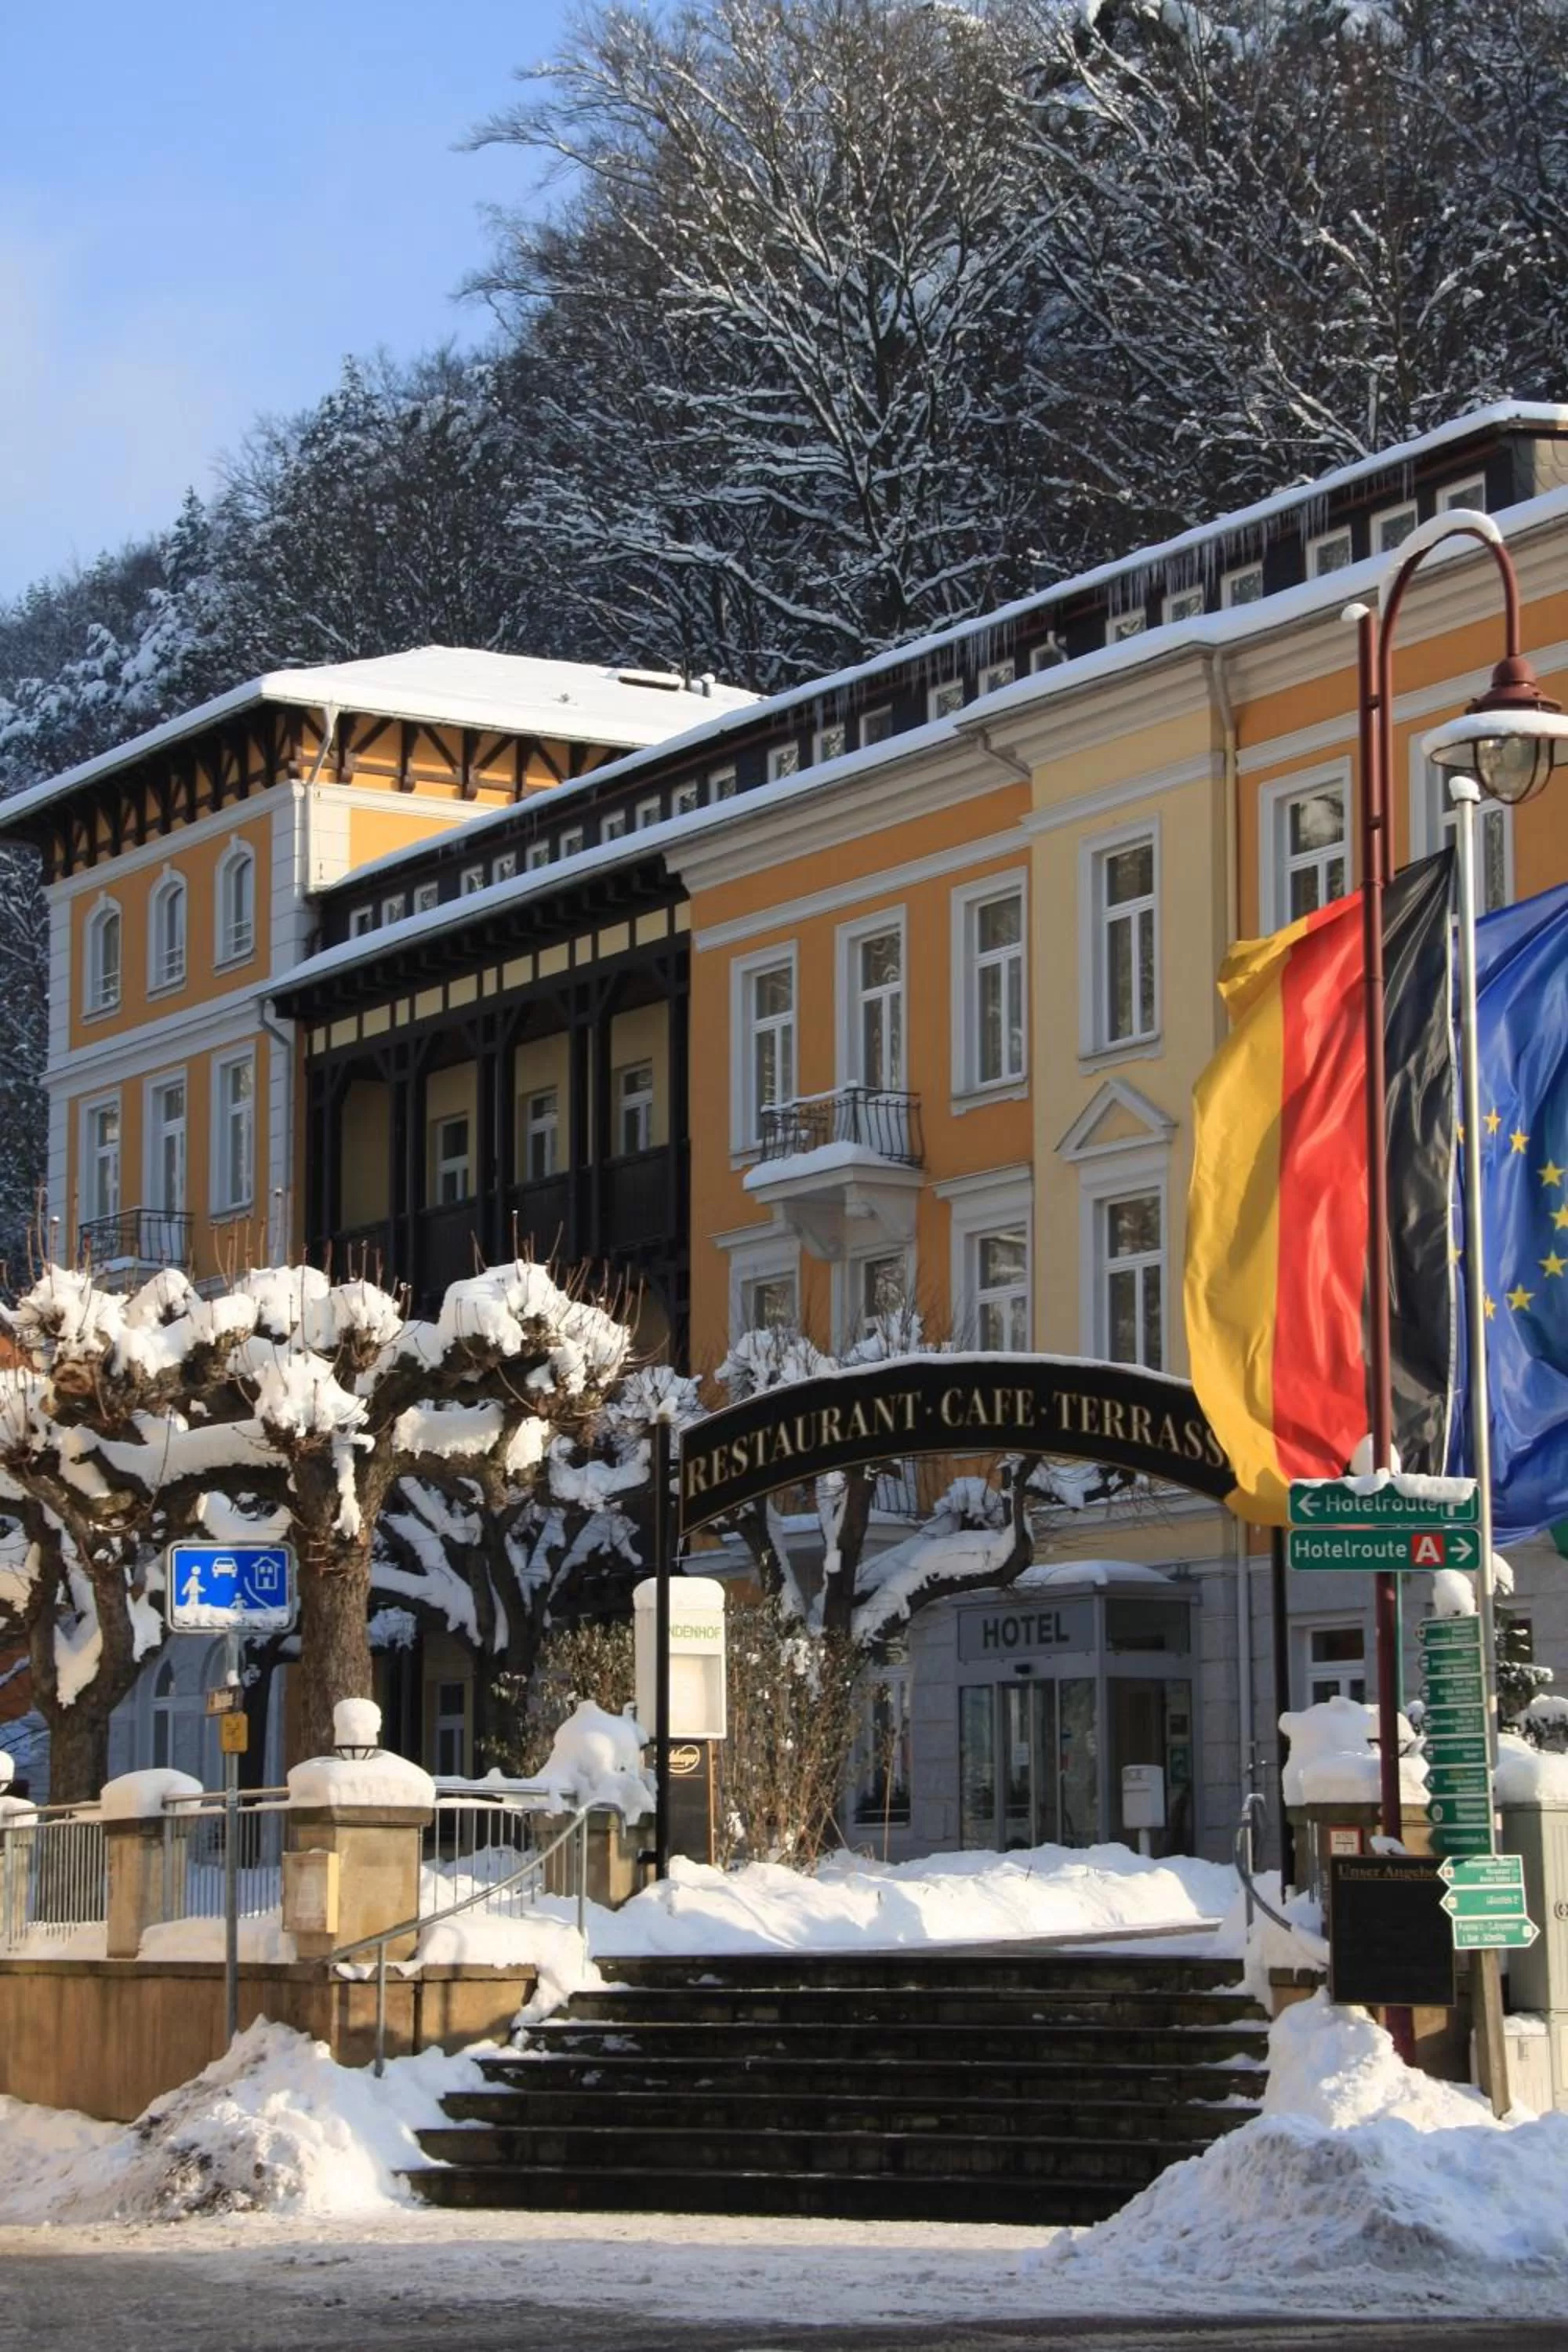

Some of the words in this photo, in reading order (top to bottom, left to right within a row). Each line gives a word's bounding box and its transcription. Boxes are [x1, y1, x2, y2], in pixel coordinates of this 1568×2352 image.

[686, 1389, 923, 1499] RESTAURANT
[941, 1388, 1036, 1427] CAFE
[1052, 1390, 1225, 1468] TERRASS
[1325, 1494, 1438, 1513] Hotelroute
[1294, 1538, 1407, 1559] Hotelroute
[1415, 1536, 1442, 1563] A
[670, 1624, 722, 1639] NDENHOF
[982, 1611, 1070, 1650] HOTEL
[1384, 1864, 1436, 1882] Angebo
